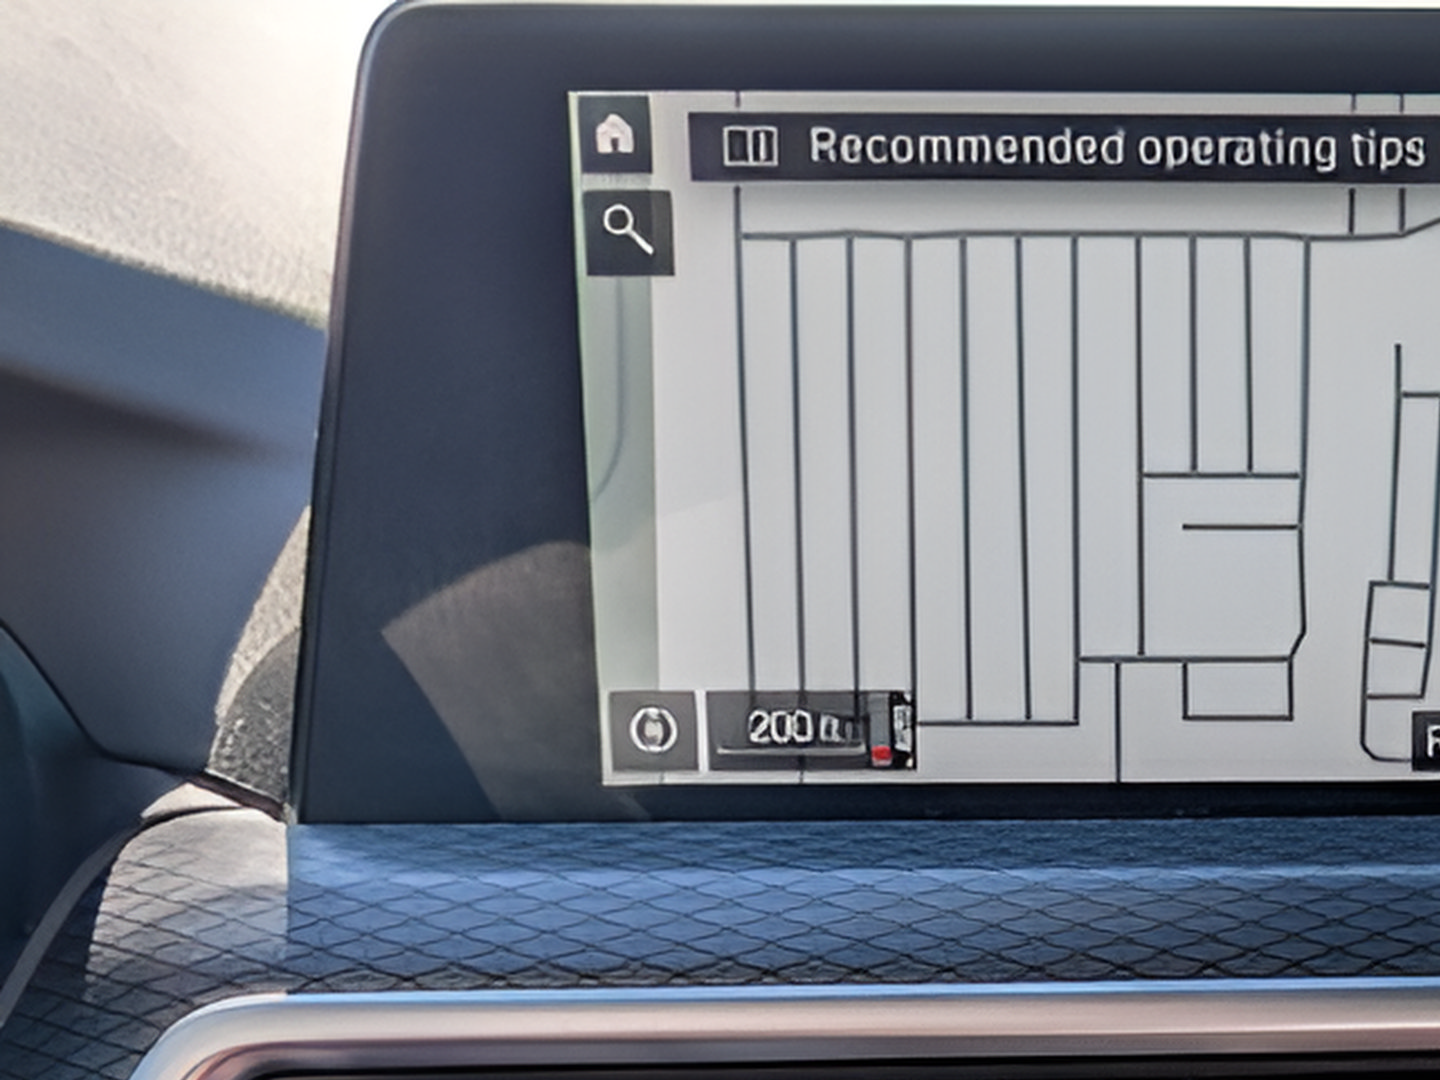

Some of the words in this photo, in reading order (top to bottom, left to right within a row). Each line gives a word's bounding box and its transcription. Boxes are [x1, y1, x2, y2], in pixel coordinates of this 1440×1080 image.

[809, 126, 1125, 165] Recommended
[1137, 129, 1337, 173] operating
[1350, 129, 1426, 171] tips
[748, 709, 814, 744] 200
